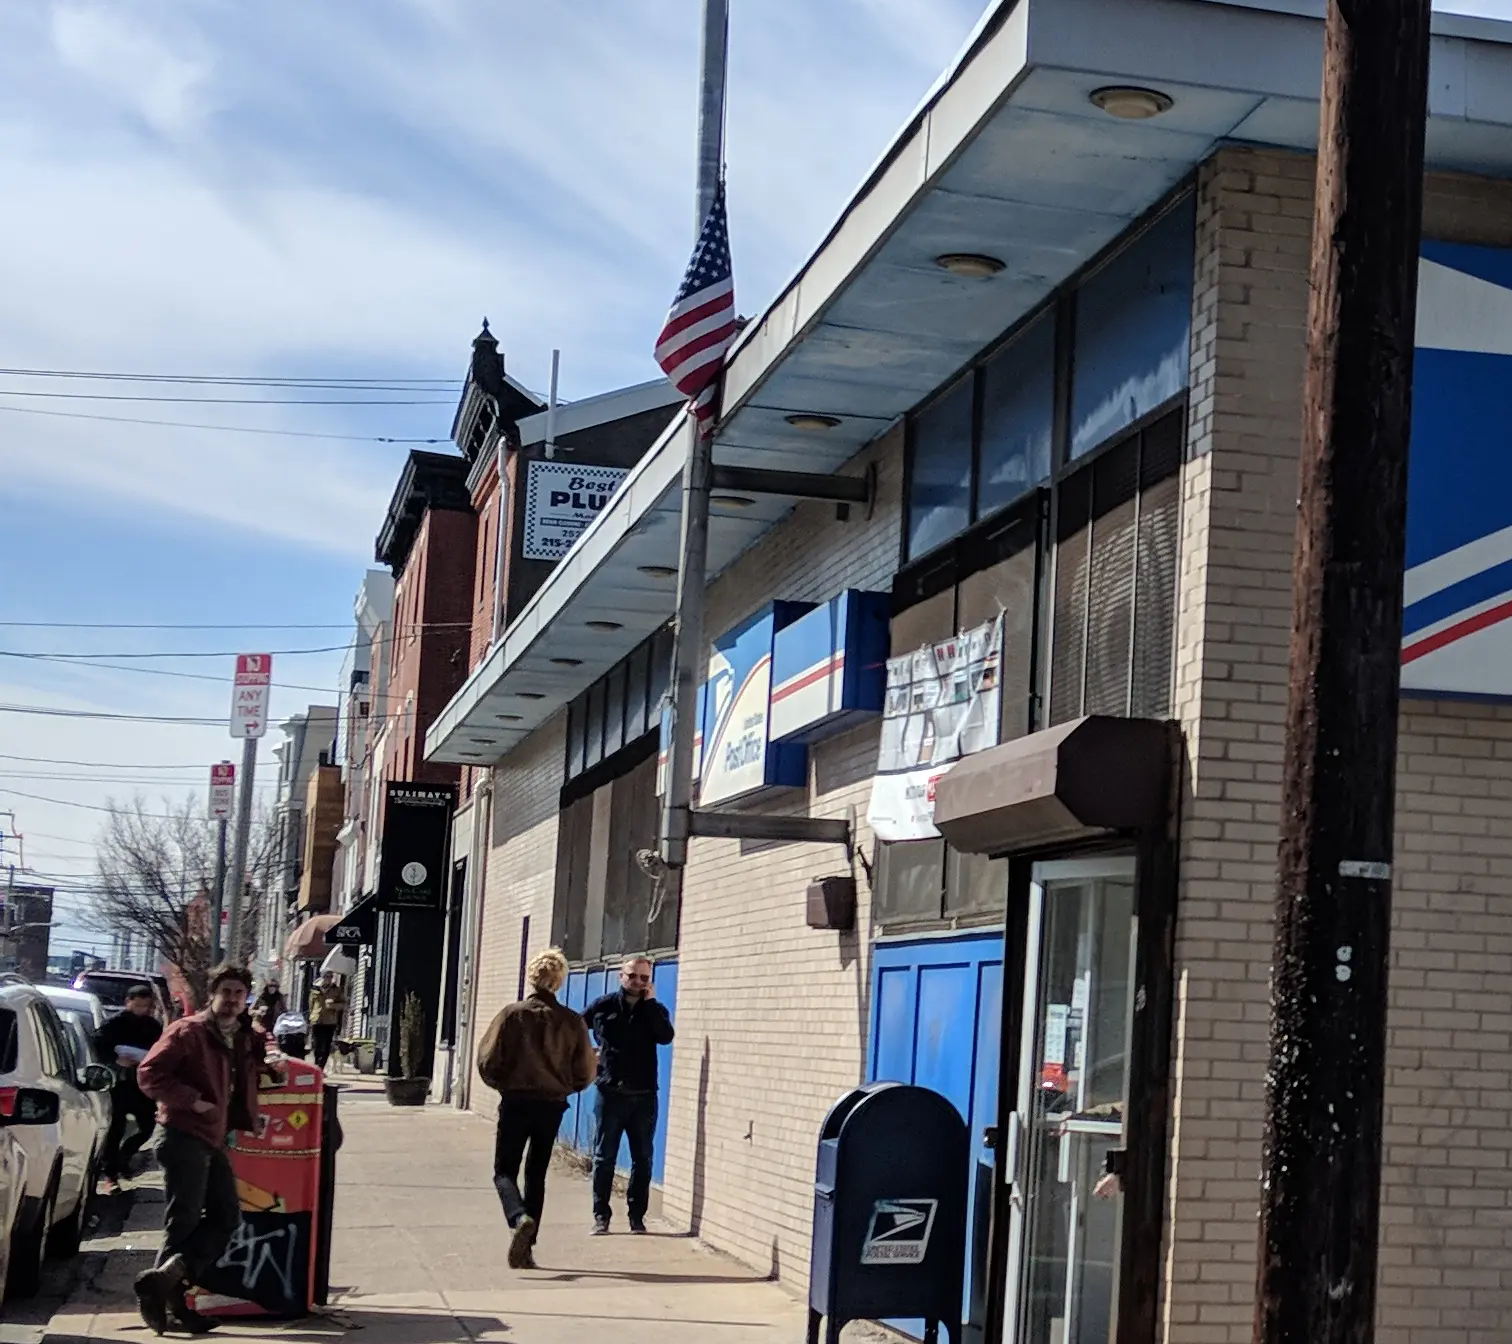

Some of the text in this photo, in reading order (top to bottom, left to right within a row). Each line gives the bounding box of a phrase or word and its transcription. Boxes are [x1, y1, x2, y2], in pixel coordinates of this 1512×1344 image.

[568, 477, 616, 492] Best
[549, 490, 612, 511] PLU
[238, 689, 263, 702] ANY
[237, 705, 261, 718] TIME
[389, 789, 452, 800] SULIMAY'S
